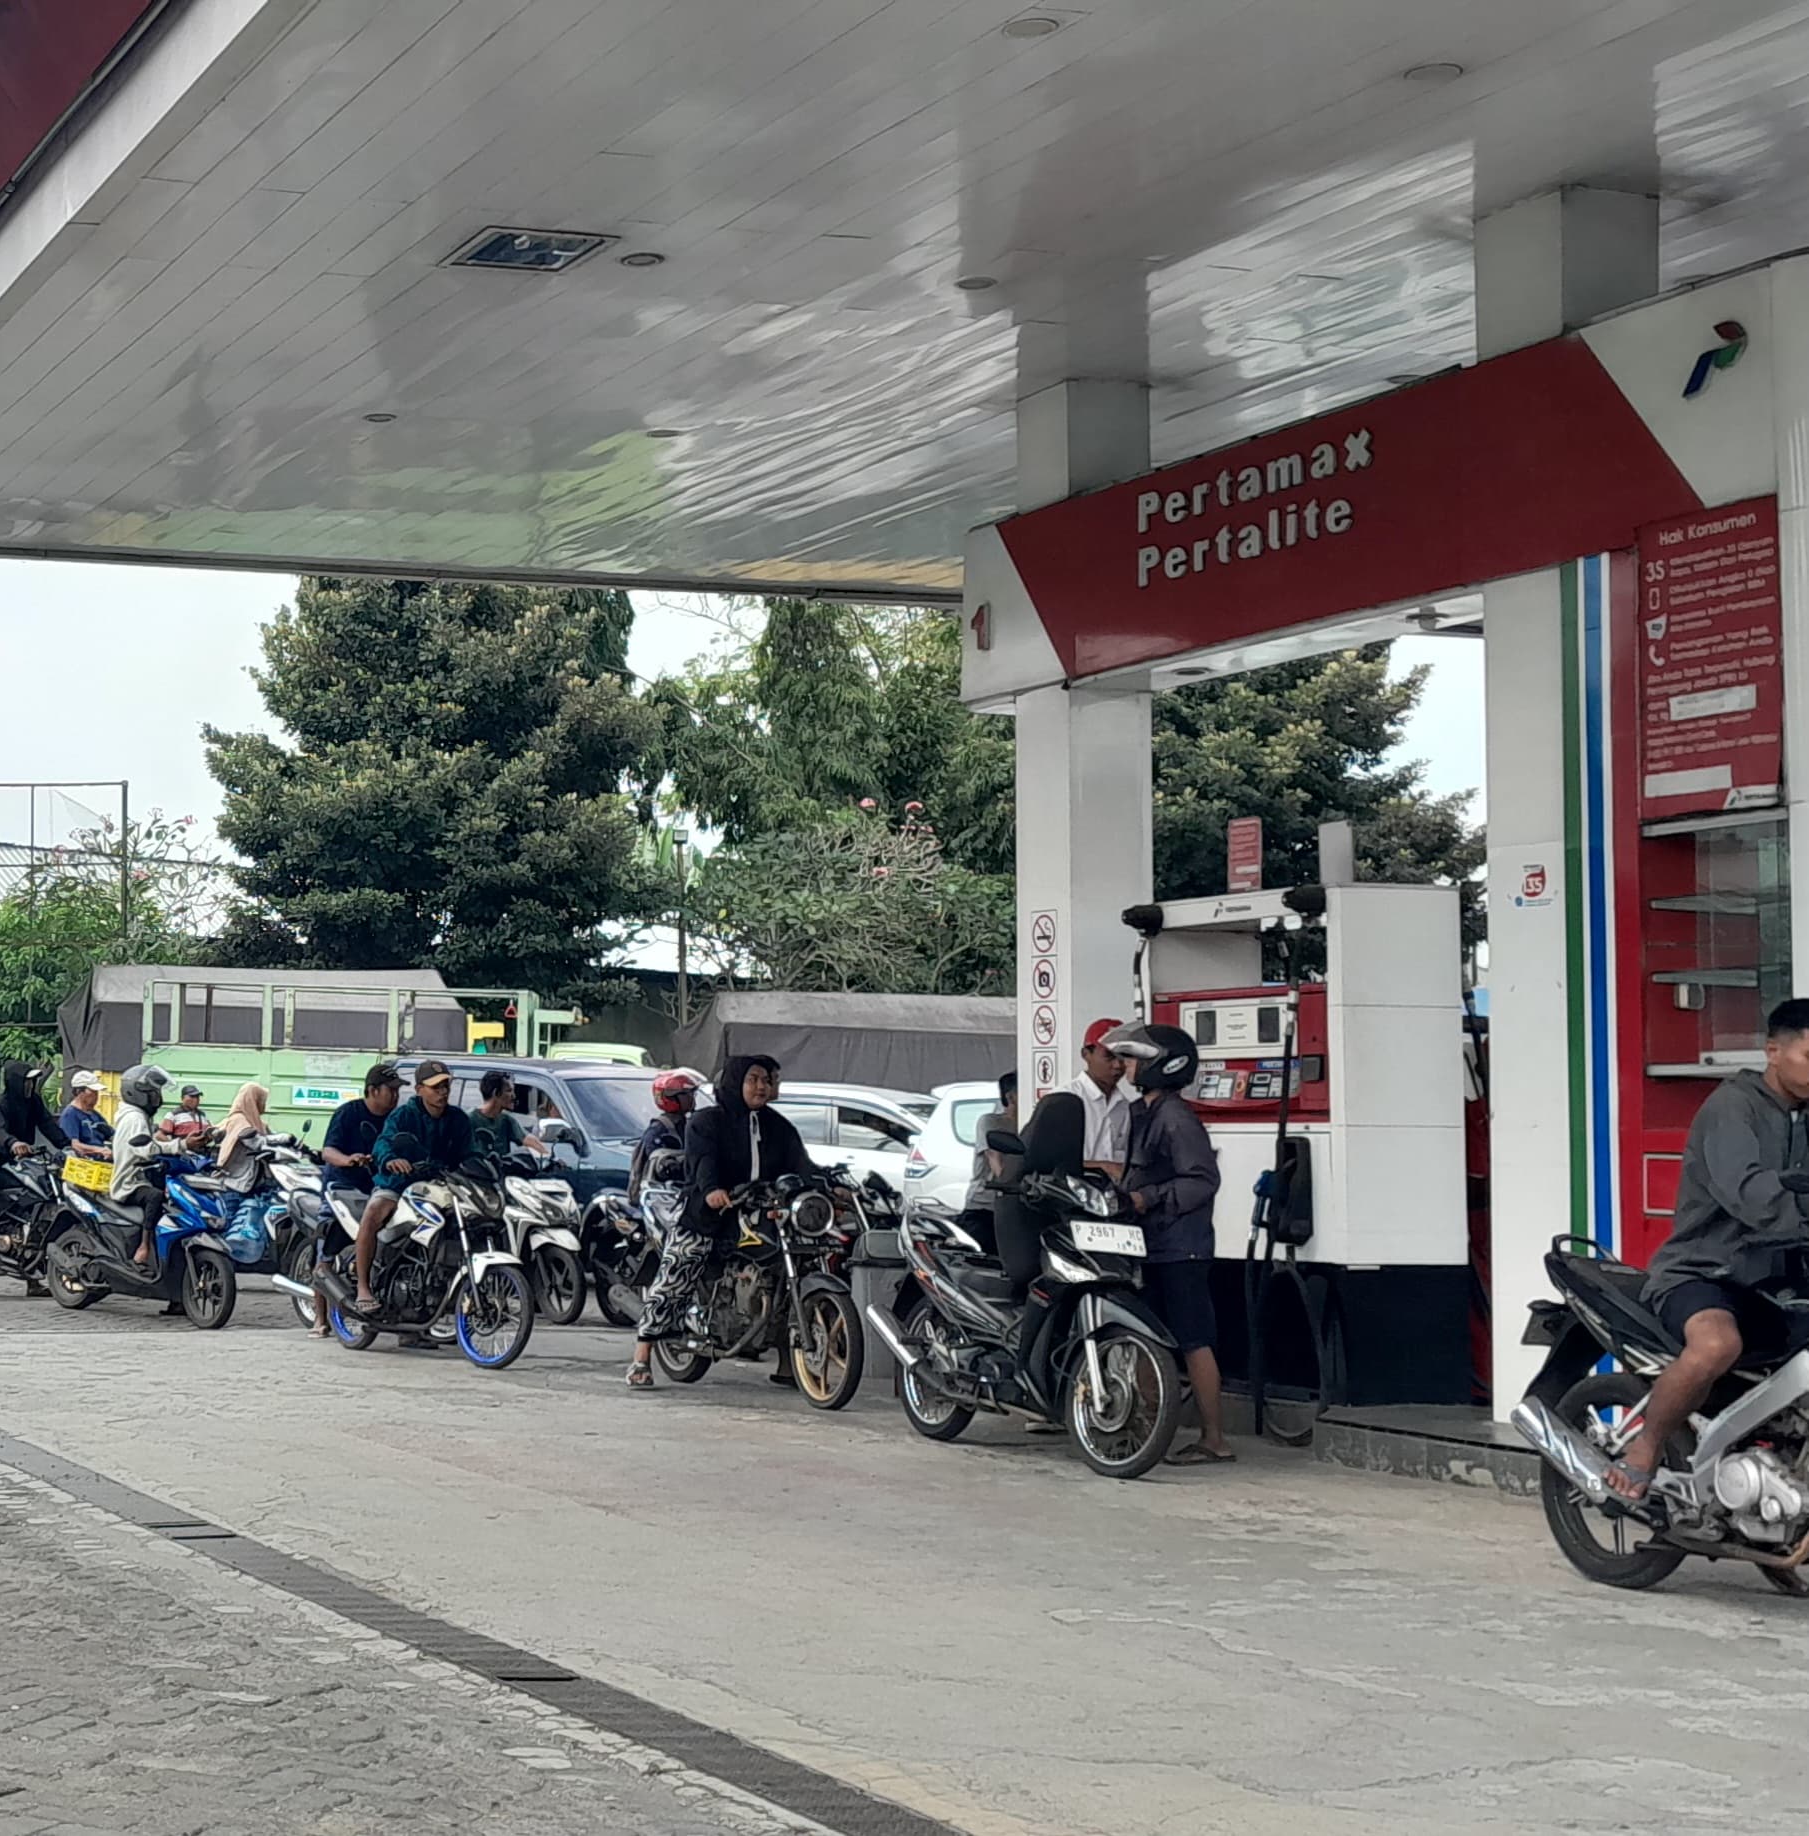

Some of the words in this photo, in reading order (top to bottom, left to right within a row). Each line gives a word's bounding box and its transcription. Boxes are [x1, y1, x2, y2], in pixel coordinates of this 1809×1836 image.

[1137, 428, 1372, 534] Pertamax
[1137, 498, 1353, 588] Pertalite
[1658, 528, 1684, 546] Hak
[1687, 512, 1757, 540] Konsumen
